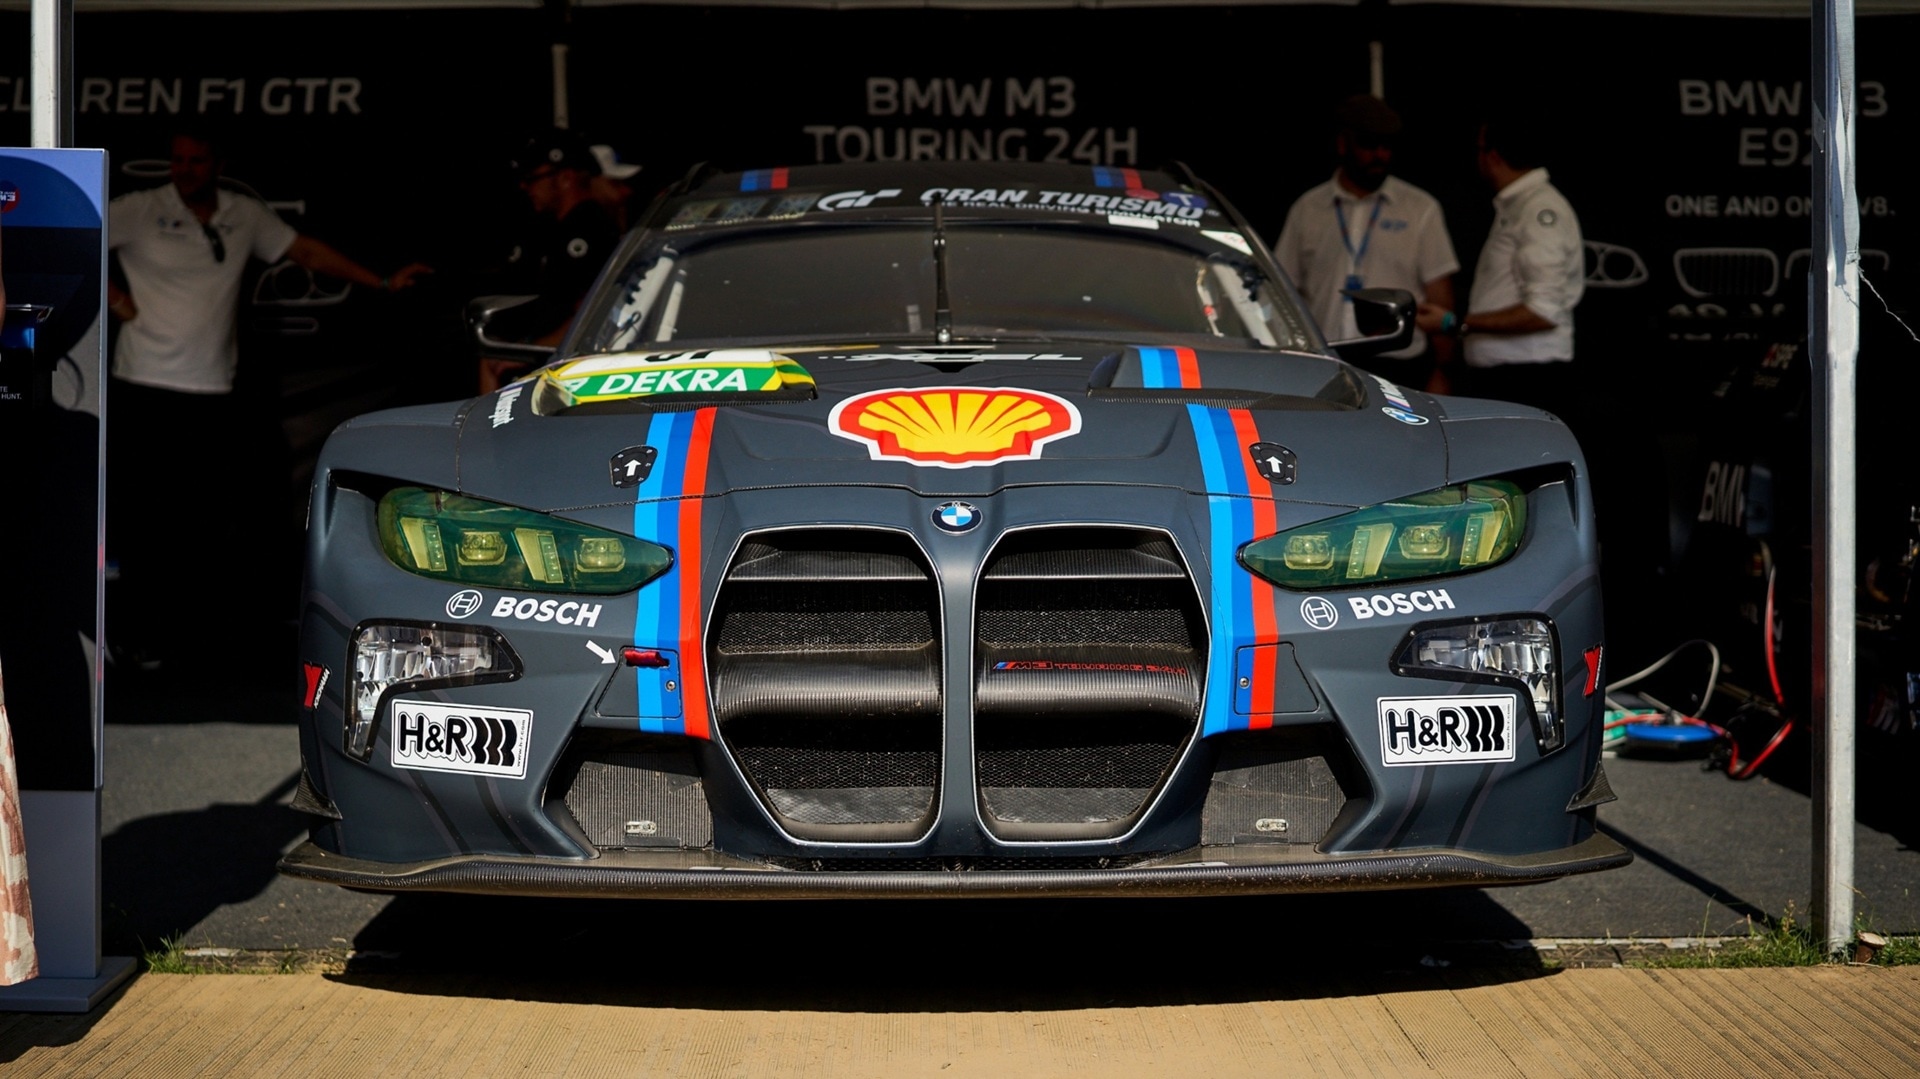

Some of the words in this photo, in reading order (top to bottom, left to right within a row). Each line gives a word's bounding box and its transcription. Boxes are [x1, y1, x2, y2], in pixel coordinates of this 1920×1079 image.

[197, 76, 248, 115] F1
[260, 76, 363, 116] GTR
[865, 75, 992, 119] BMW
[1004, 75, 1077, 119] M3
[1677, 78, 1803, 118] BMW
[801, 124, 1031, 162] TOURING
[1042, 125, 1139, 167] 24H
[920, 188, 1029, 204] GRAN
[1039, 189, 1204, 219] TURISMO
[1664, 194, 1720, 218] ONE
[1723, 194, 1780, 218] AND
[597, 368, 748, 394] DEKRA
[491, 596, 603, 628] BOSCH
[1348, 588, 1456, 620] BOSCH
[399, 711, 471, 761] H&R
[1387, 708, 1465, 753] H&R
